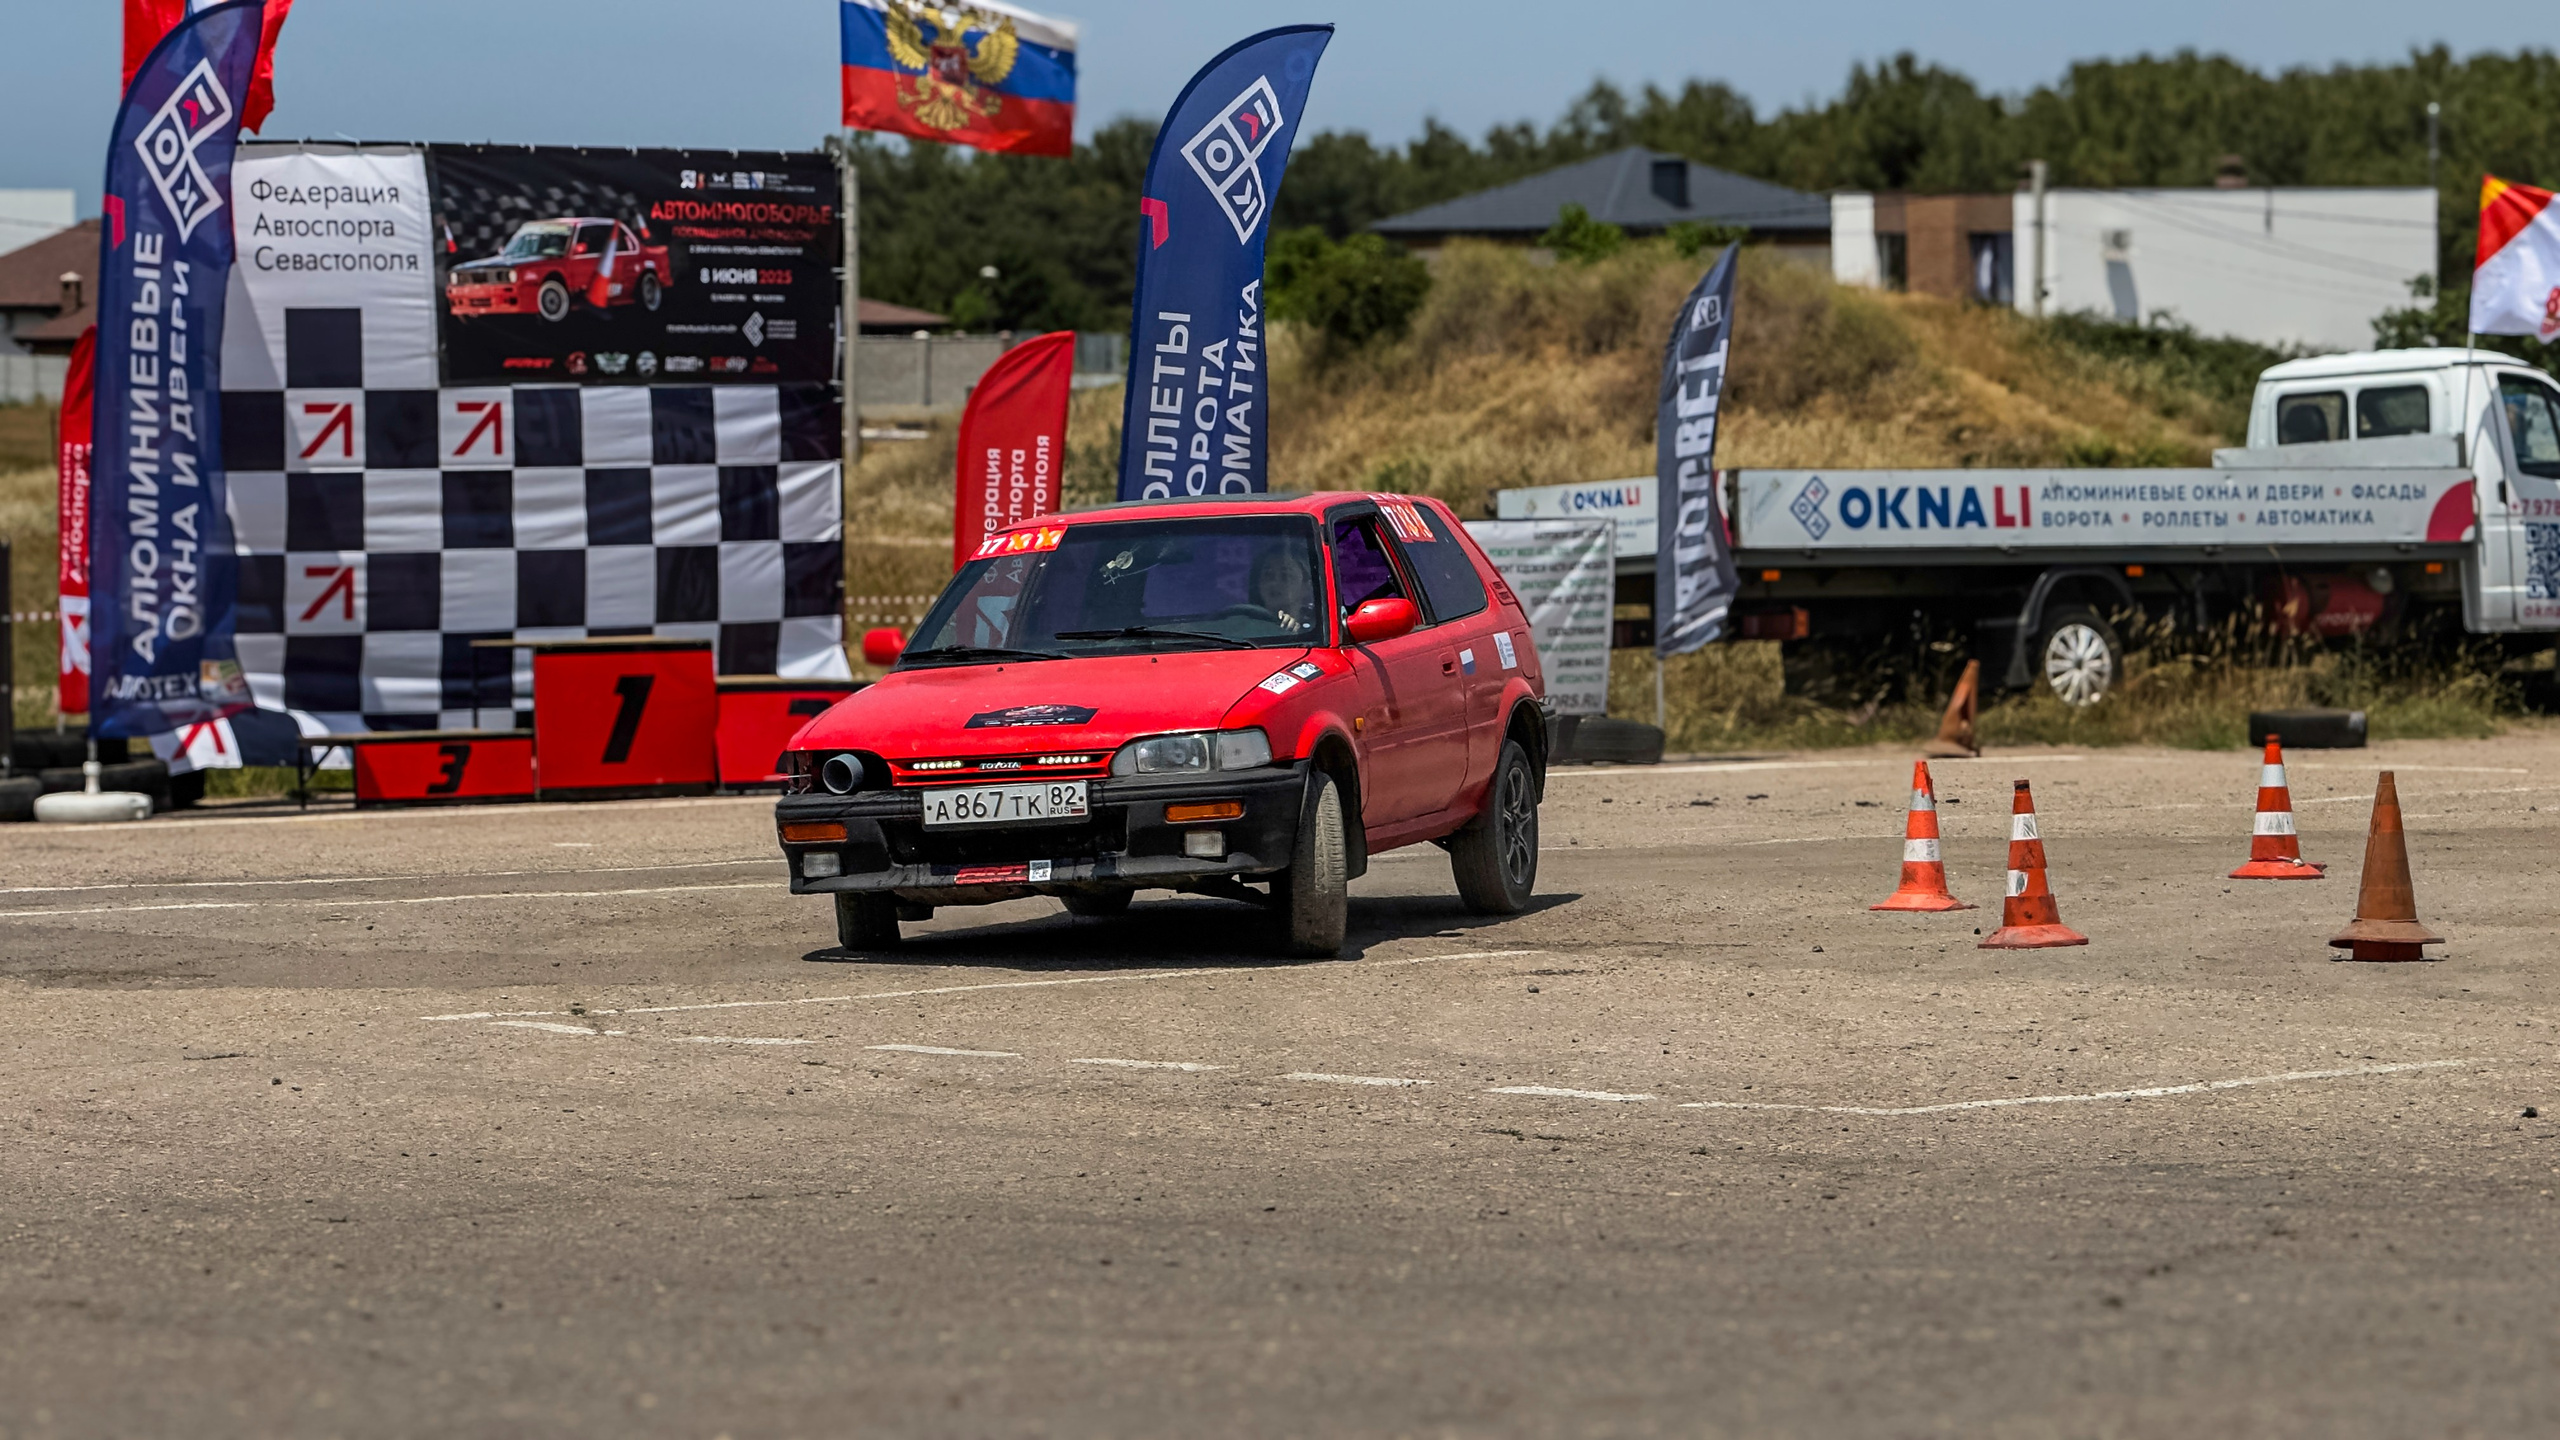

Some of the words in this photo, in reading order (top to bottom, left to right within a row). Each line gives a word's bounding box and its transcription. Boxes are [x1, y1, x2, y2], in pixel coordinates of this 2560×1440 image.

[251, 178, 400, 209] Федерация
[651, 201, 832, 224] АВТОМНОГОБОРЬЕ
[253, 212, 396, 244] Автоспорта
[255, 246, 419, 271] Севастополя
[700, 267, 710, 284] 8
[712, 267, 757, 284] ИЮНЯ
[759, 269, 792, 284] 2025
[169, 261, 197, 442] ДВЕРИ
[128, 232, 163, 664] АЛЮМИНИЕВЫЕ
[171, 452, 199, 487] И
[1574, 486, 1641, 510] OKNALI
[2042, 484, 2187, 502] АЛЮМИНИЕВЫЕ
[2193, 484, 2241, 501] ОКНА
[2247, 484, 2259, 500] И
[2265, 484, 2325, 502] ДВЕРИ
[2352, 484, 2427, 502] ФАСАДЫ
[1839, 486, 2031, 529] OKNALI
[2042, 511, 2112, 527] ВОРОТА
[2143, 511, 2229, 527] РОЛЛЕТЫ
[2256, 510, 2374, 526] АВТОМАТИКА
[978, 537, 1006, 555] 17
[166, 503, 200, 640] ОКНА
[602, 674, 655, 764] 1
[427, 745, 470, 794] 3
[979, 762, 1022, 770] TOYOTA
[1050, 785, 1077, 806] 82
[1050, 807, 1070, 815] RUS
